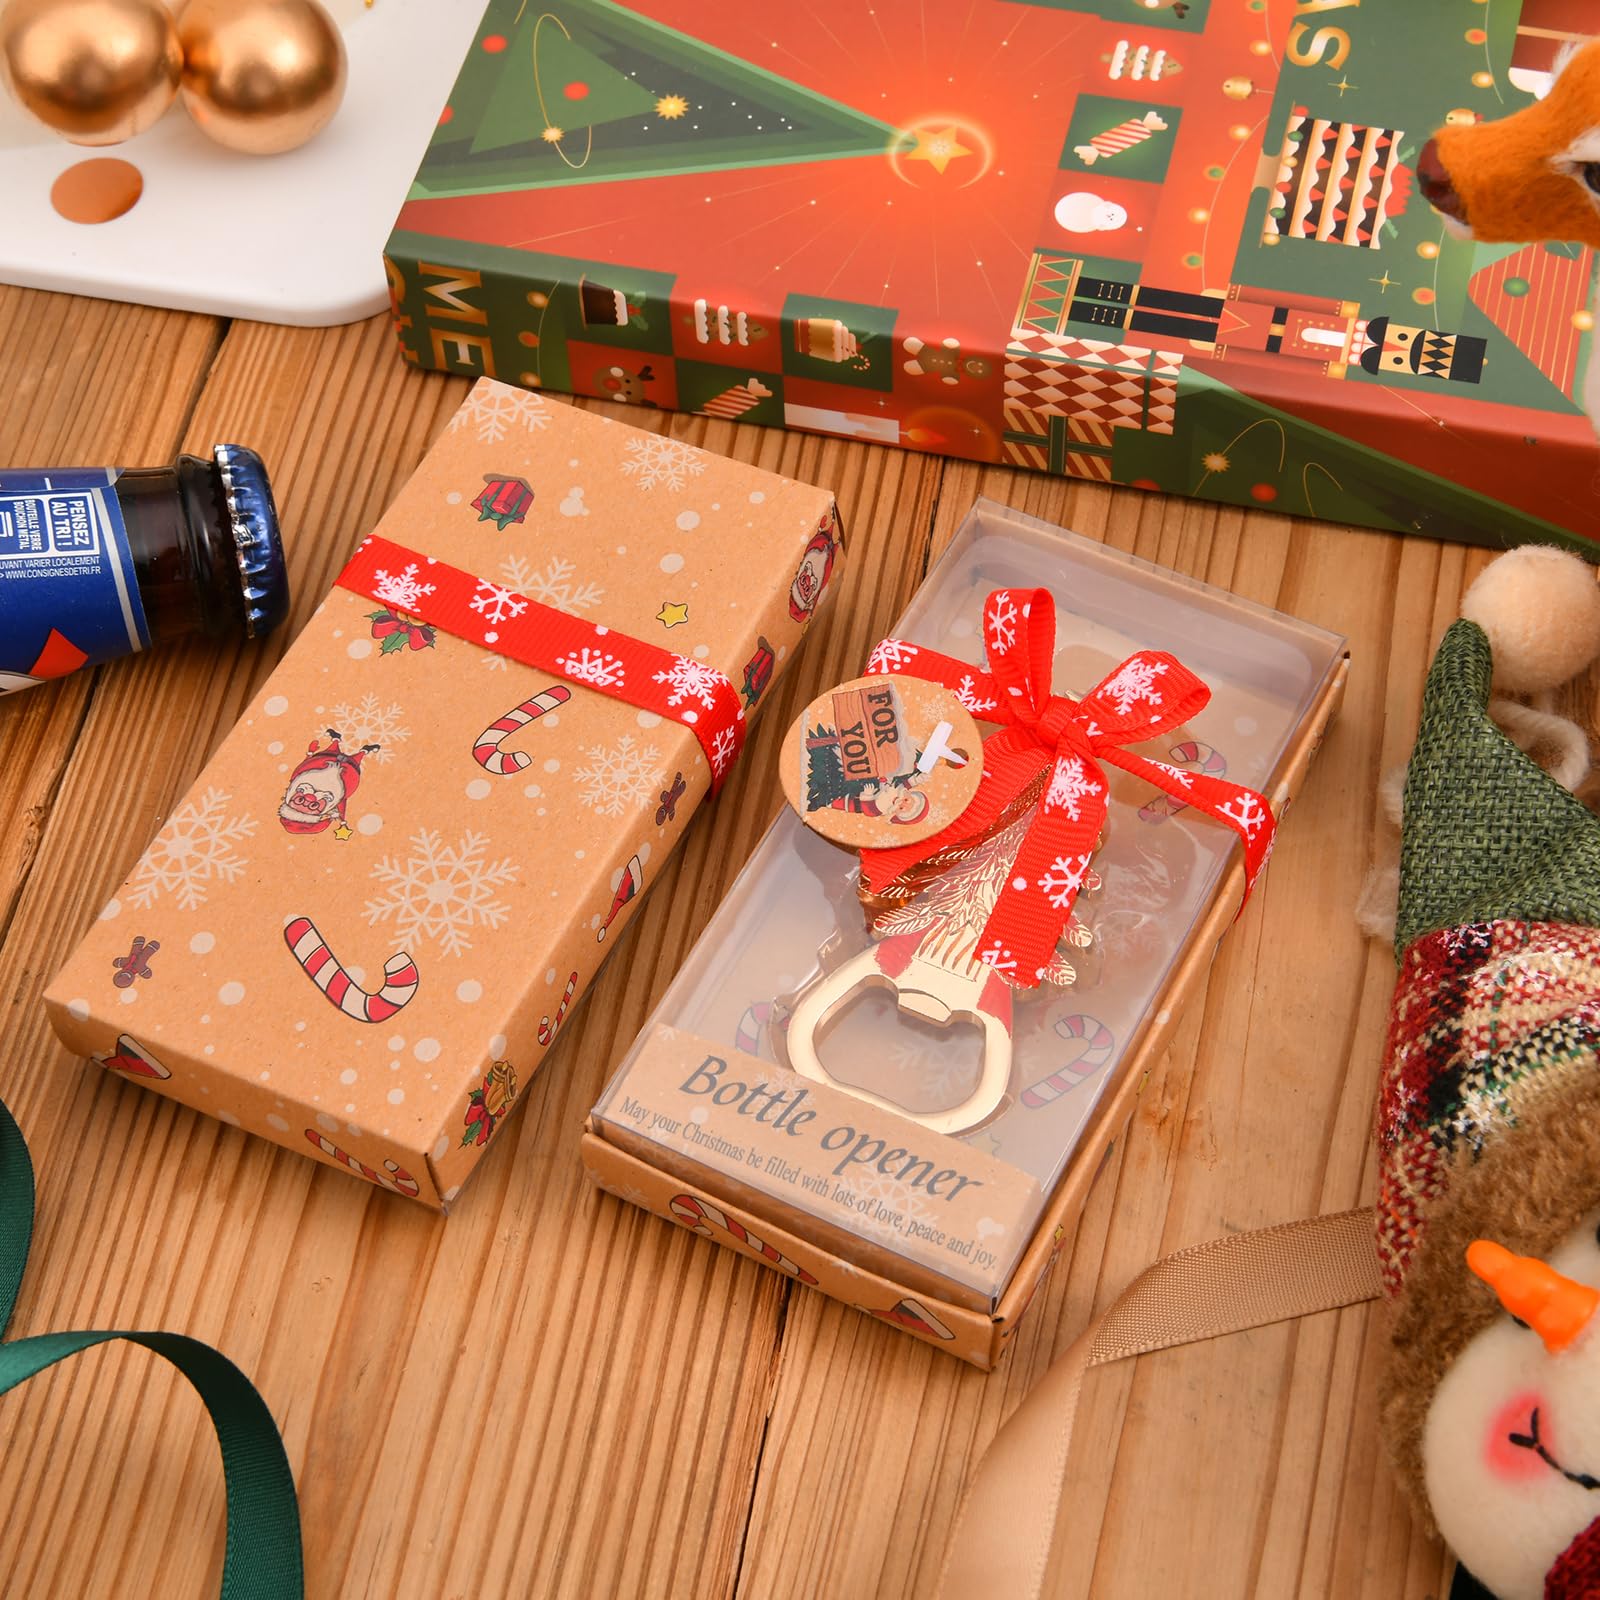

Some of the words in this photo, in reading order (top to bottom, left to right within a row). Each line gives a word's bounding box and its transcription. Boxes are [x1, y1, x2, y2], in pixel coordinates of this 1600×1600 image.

[13, 501, 27, 528] BOUCHON
[24, 499, 39, 529] BOUTEILLE
[51, 501, 68, 516] AU
[54, 518, 71, 539] TRI
[69, 500, 90, 546] PENSEZ
[18, 529, 30, 549] METAL
[29, 529, 42, 550] VERRE
[5, 566, 101, 579] WWW.CONSIGNESDETRI.FR
[23, 559, 50, 568] VARIER
[51, 556, 100, 567] LOCALEMENT
[867, 690, 899, 749] FOR
[840, 721, 872, 775] YOU
[678, 1054, 817, 1137] Bottle
[820, 1126, 985, 1202] opener
[619, 1095, 650, 1122] May
[647, 1112, 682, 1136] your
[682, 1120, 745, 1163] Christmas
[746, 1146, 764, 1168] be
[764, 1156, 802, 1184] filled
[801, 1173, 830, 1198] with
[831, 1183, 856, 1208] lots
[856, 1198, 877, 1216] of
[874, 1206, 904, 1232] love,
[905, 1218, 946, 1246] peace
[946, 1236, 974, 1257] and
[969, 1244, 998, 1271] joy.
